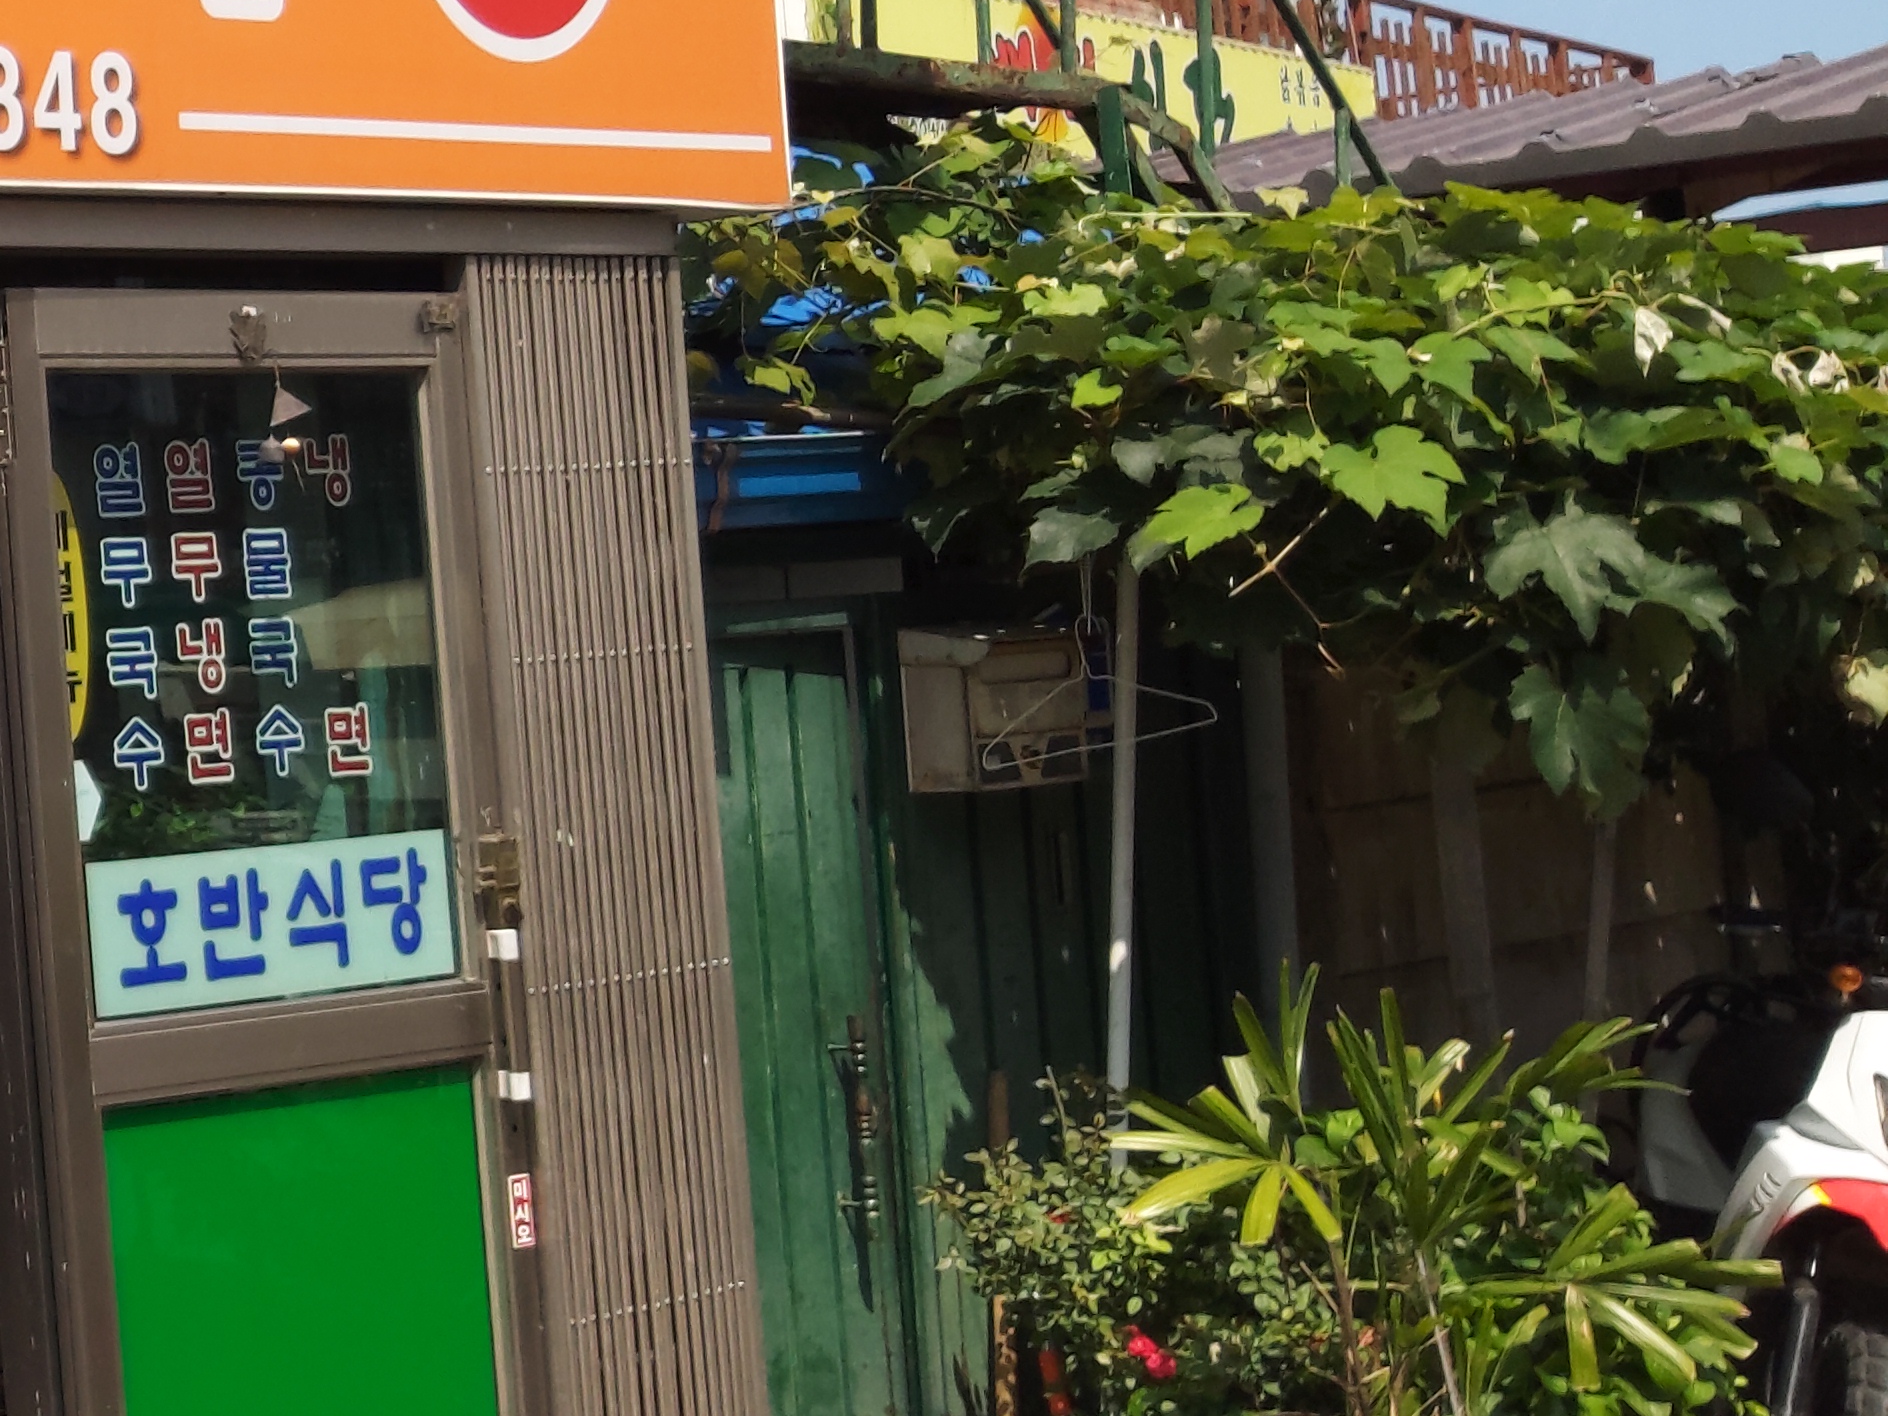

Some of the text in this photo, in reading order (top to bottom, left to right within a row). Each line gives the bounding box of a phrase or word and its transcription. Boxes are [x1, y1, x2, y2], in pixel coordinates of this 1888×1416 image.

[94, 441, 165, 791] 열무국수
[164, 438, 234, 785] 열무냉면
[117, 847, 427, 988] 호반식당
[513, 1178, 532, 1244] 미시오
